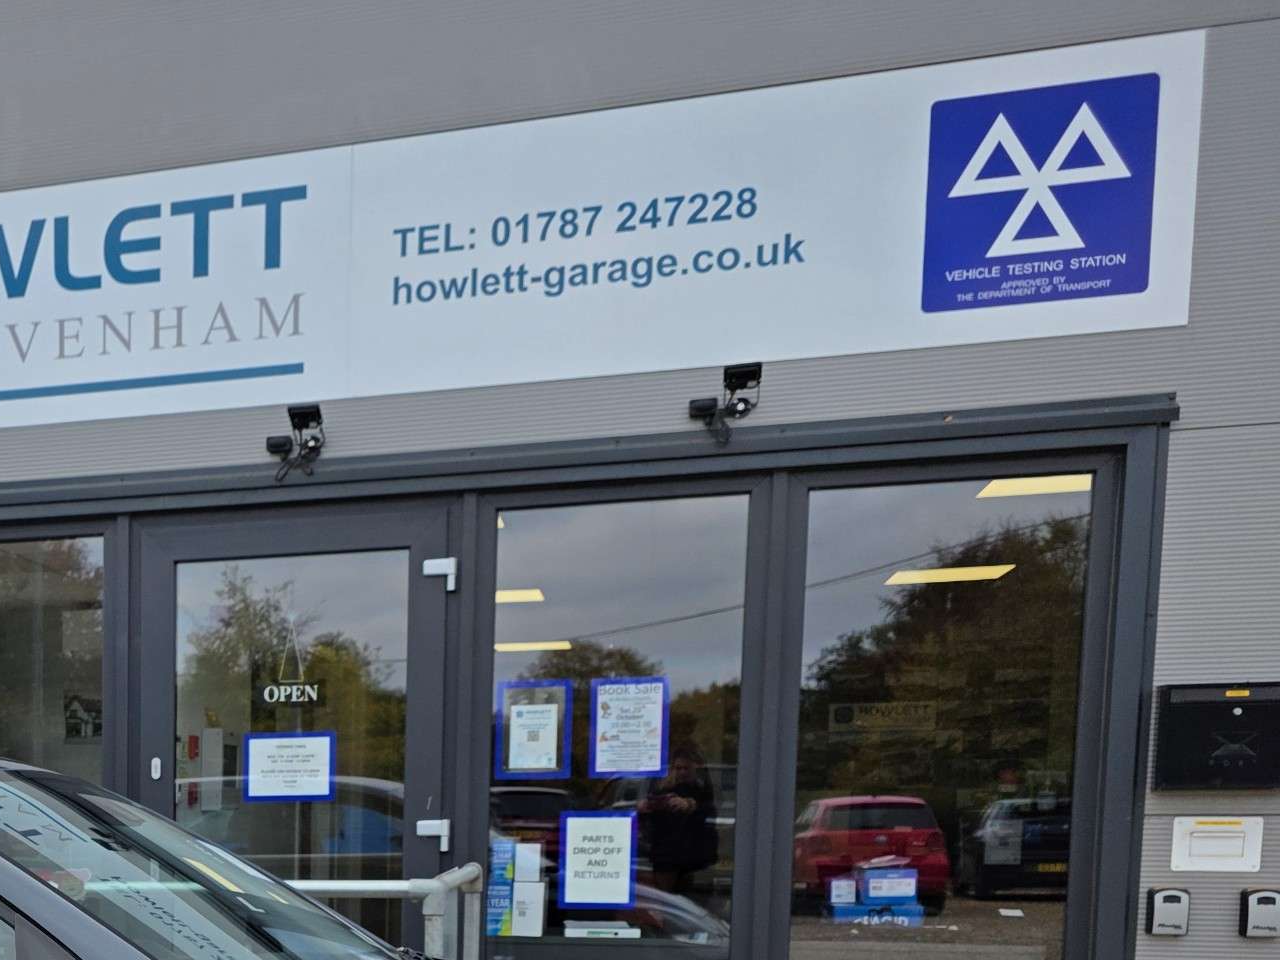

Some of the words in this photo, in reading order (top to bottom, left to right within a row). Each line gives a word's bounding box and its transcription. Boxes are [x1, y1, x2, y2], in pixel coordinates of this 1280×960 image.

[393, 223, 476, 257] TEL:
[491, 205, 603, 247] 01787
[616, 187, 758, 233] 247228
[393, 233, 806, 305] howlett-garage.co.uk
[945, 266, 1000, 282] VEHICLE
[1007, 259, 1064, 276] TESTING
[1070, 253, 1127, 270] STATION
[957, 293, 974, 302] THE
[977, 287, 1036, 300] DEPARTMENT
[1040, 285, 1054, 295] OF
[1058, 279, 1112, 292] TRANSPORT
[1001, 277, 1049, 289] APPROVED
[1053, 276, 1066, 285] BY
[263, 684, 319, 703] OPEN
[582, 835, 615, 844] PARTS
[573, 847, 600, 855] DROP
[603, 847, 622, 855] OFF
[587, 859, 608, 867] AND
[574, 870, 621, 880] RETURNS
